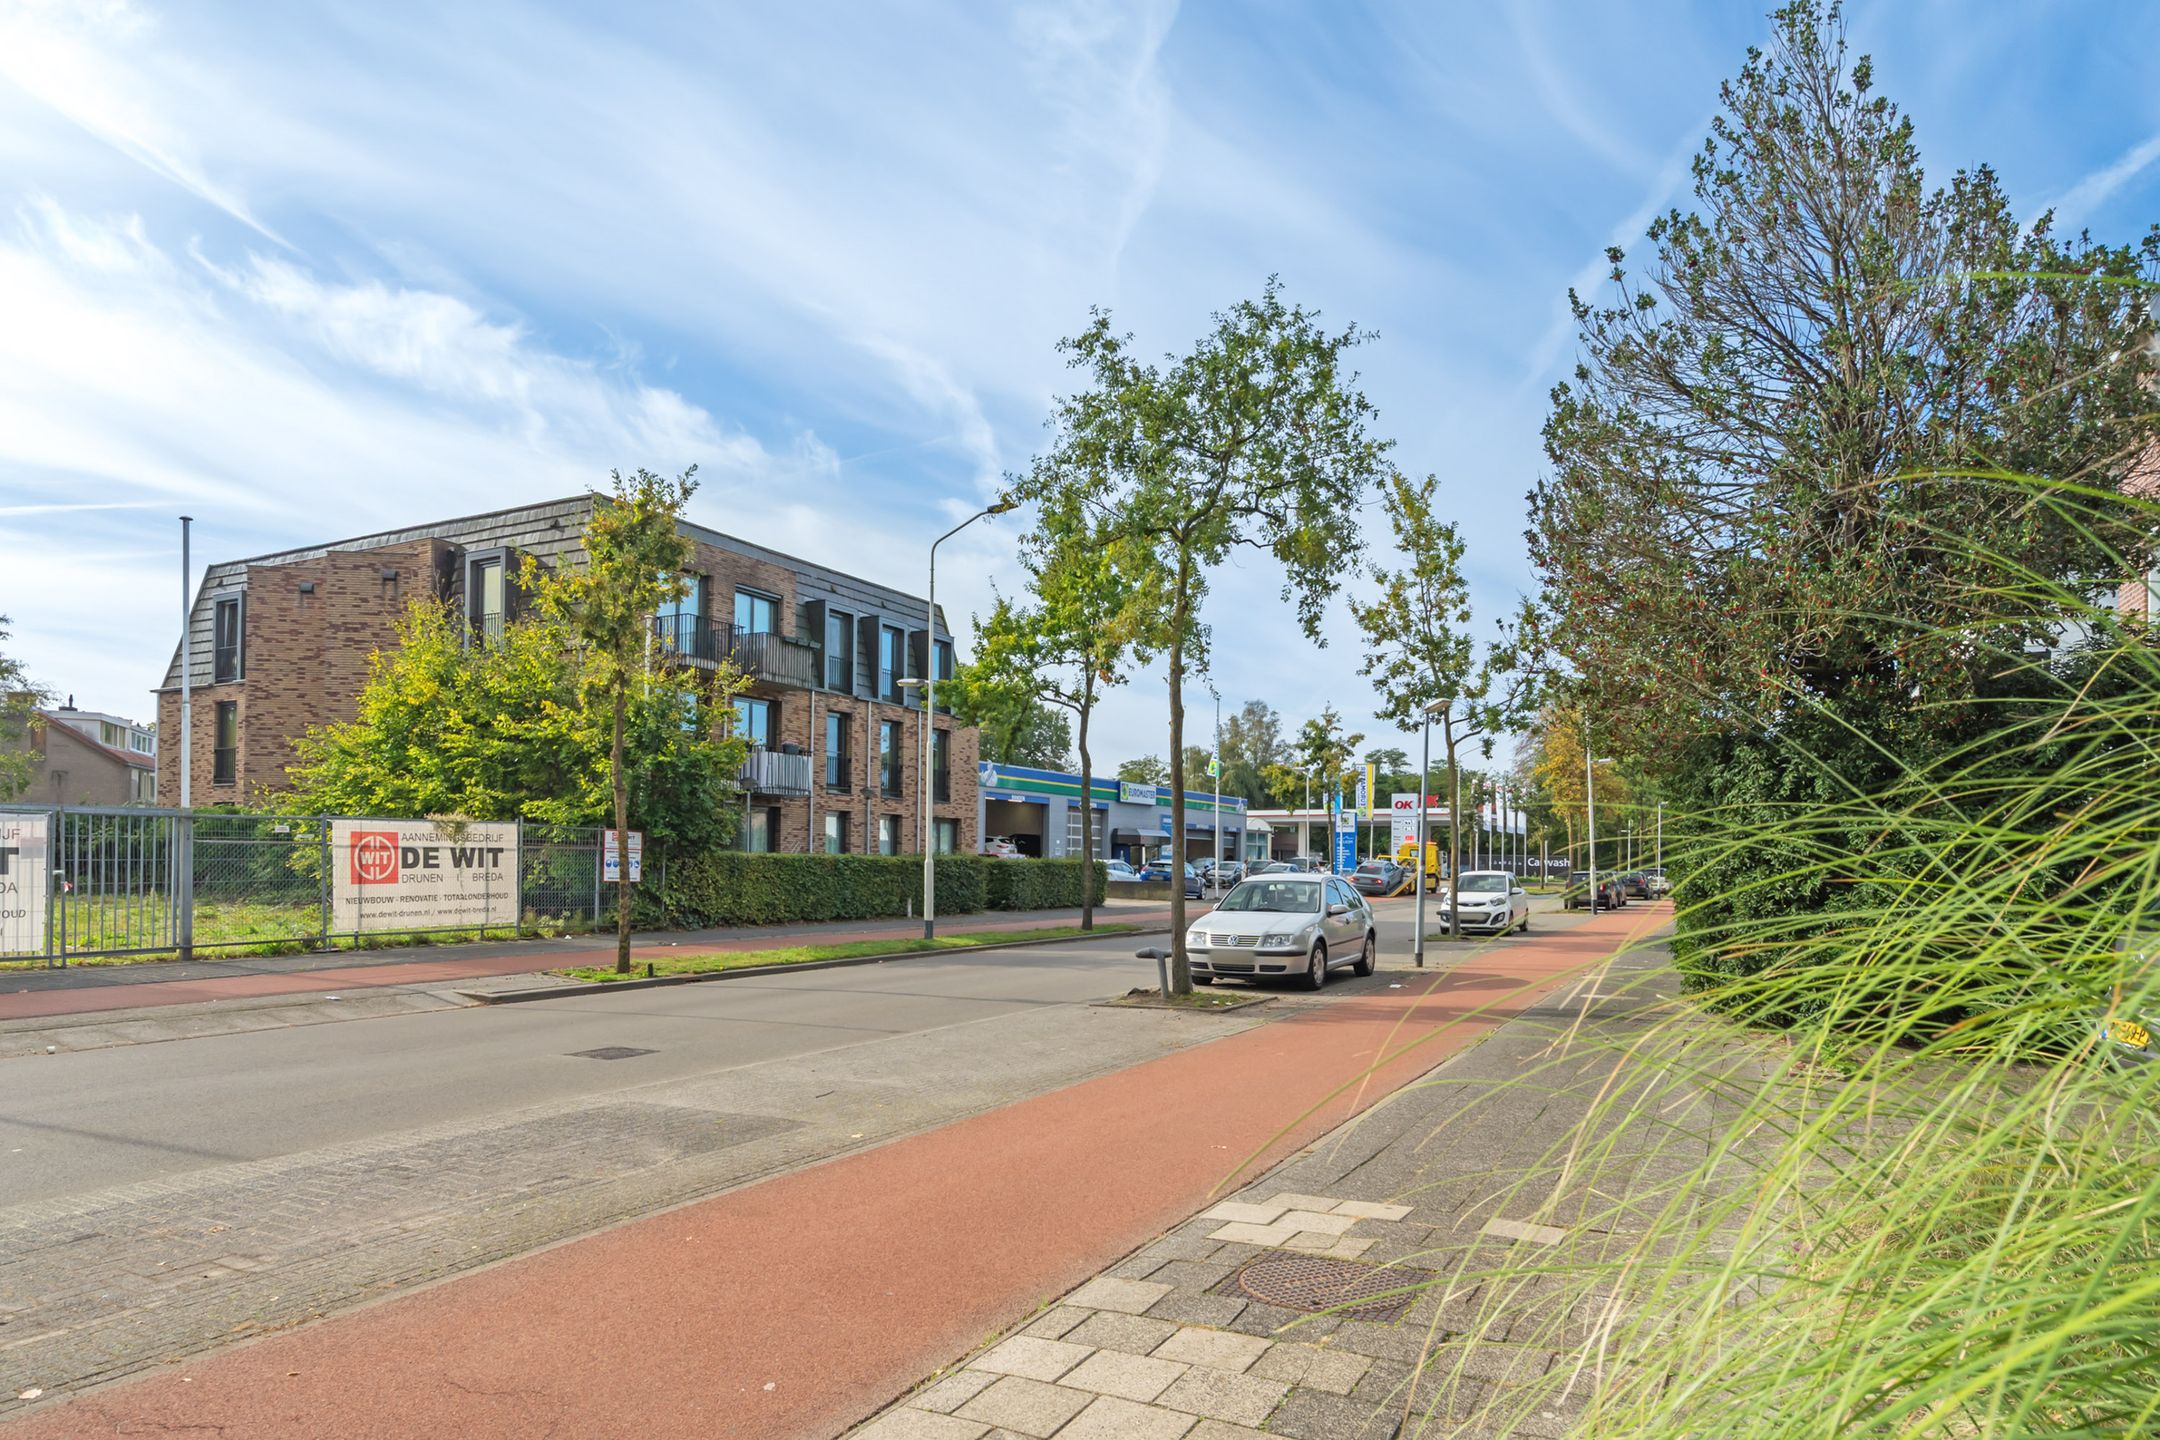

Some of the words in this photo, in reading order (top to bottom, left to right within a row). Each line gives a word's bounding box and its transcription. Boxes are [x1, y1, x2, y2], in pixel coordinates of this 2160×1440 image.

[1394, 800, 1413, 809] OK
[360, 851, 390, 864] WIT
[401, 847, 440, 869] DE
[449, 847, 504, 868] WIT
[1527, 857, 1570, 867] Cawash
[401, 873, 443, 883] DRUNEN
[472, 872, 504, 881] BREDA
[346, 896, 394, 904] NIEUWBOUW
[400, 894, 438, 903] RENOVATIE
